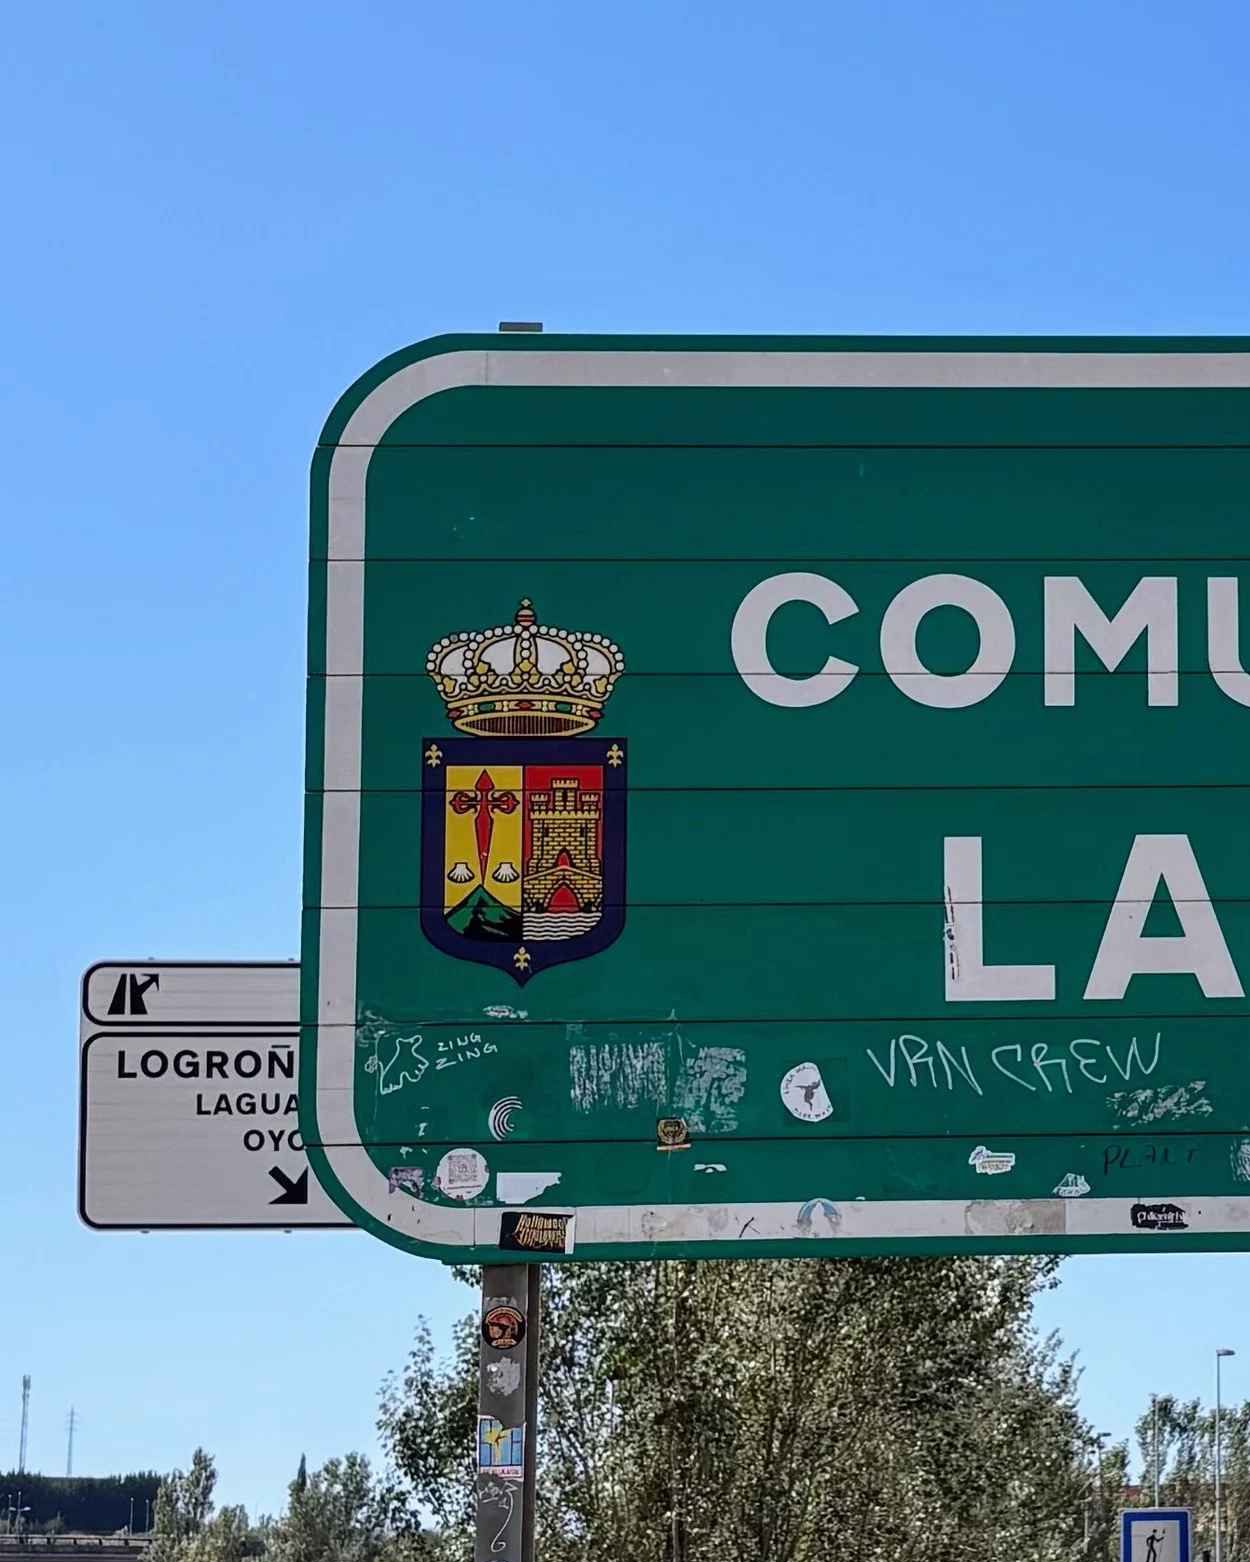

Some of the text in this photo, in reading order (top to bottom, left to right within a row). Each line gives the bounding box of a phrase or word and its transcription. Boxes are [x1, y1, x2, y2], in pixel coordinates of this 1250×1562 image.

[943, 833, 1246, 1001] LA
[117, 1045, 294, 1079] LOGROÑ
[991, 1032, 1161, 1093] CREW
